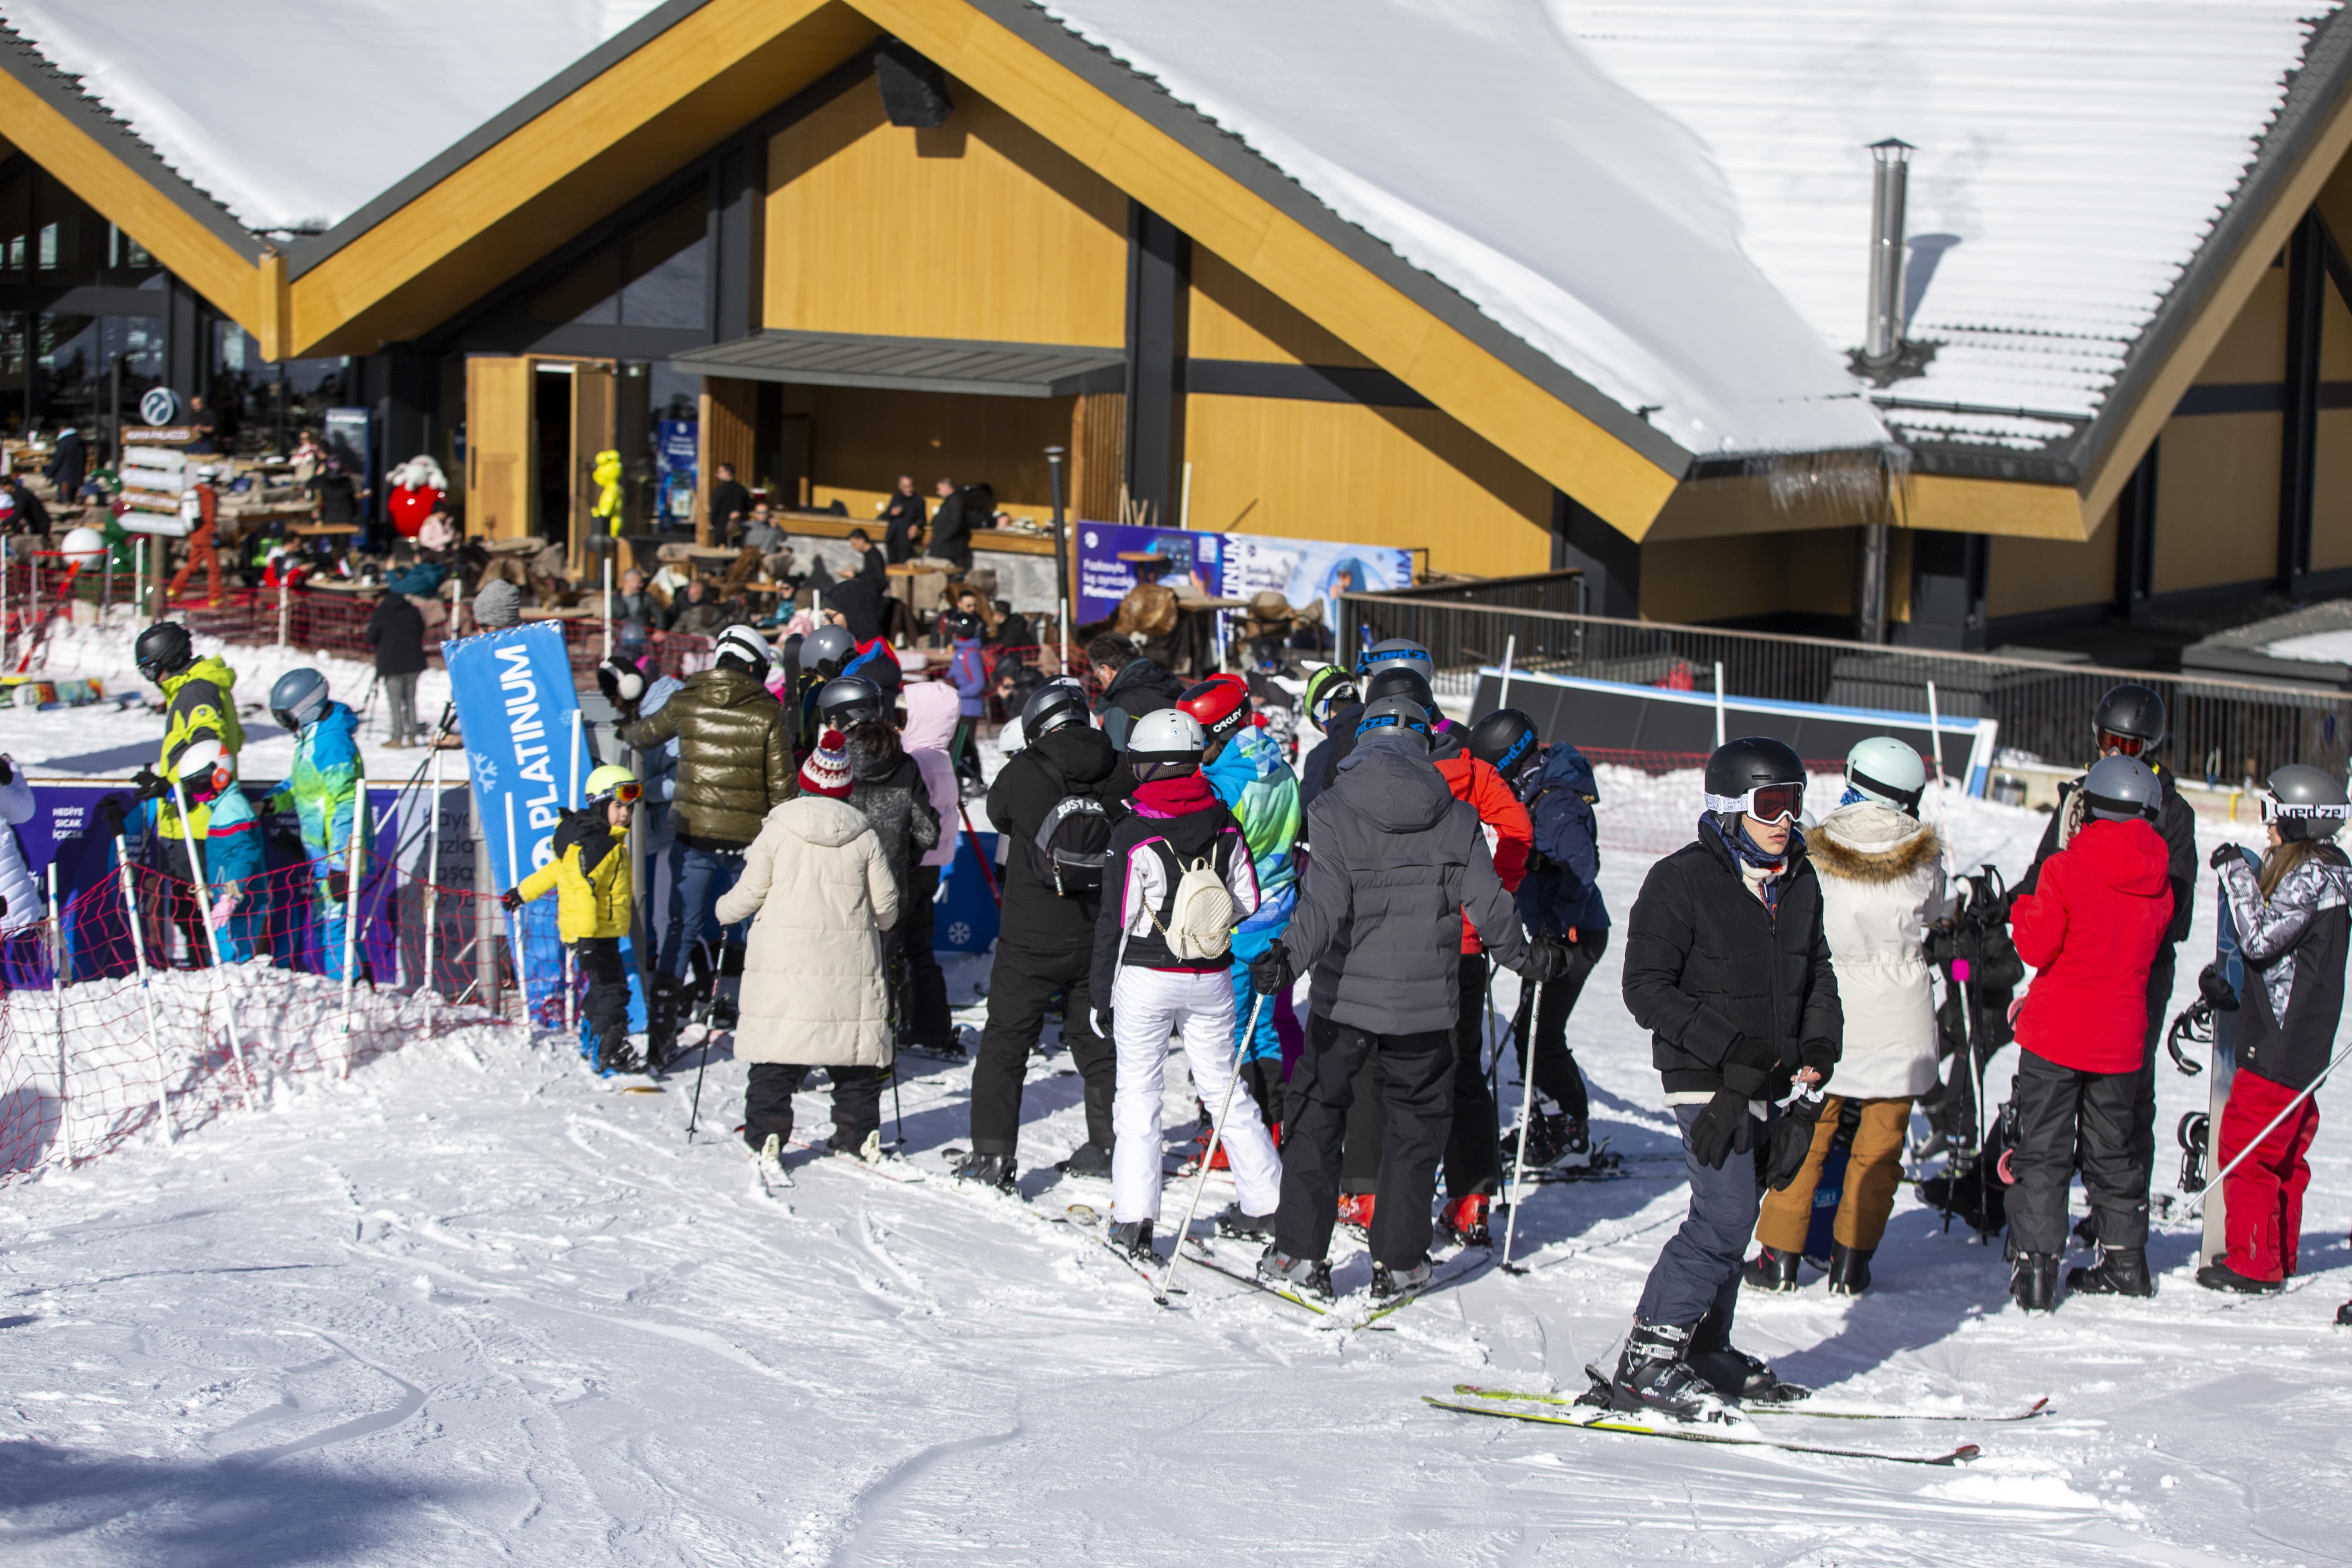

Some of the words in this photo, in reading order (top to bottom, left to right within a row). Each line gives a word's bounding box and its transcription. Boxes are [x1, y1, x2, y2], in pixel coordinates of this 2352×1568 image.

[1213, 708, 1241, 733] OAKLEY
[1354, 717, 1395, 739] ed'ze
[494, 644, 559, 830] PLATINUM
[1057, 799, 1084, 819] JUST
